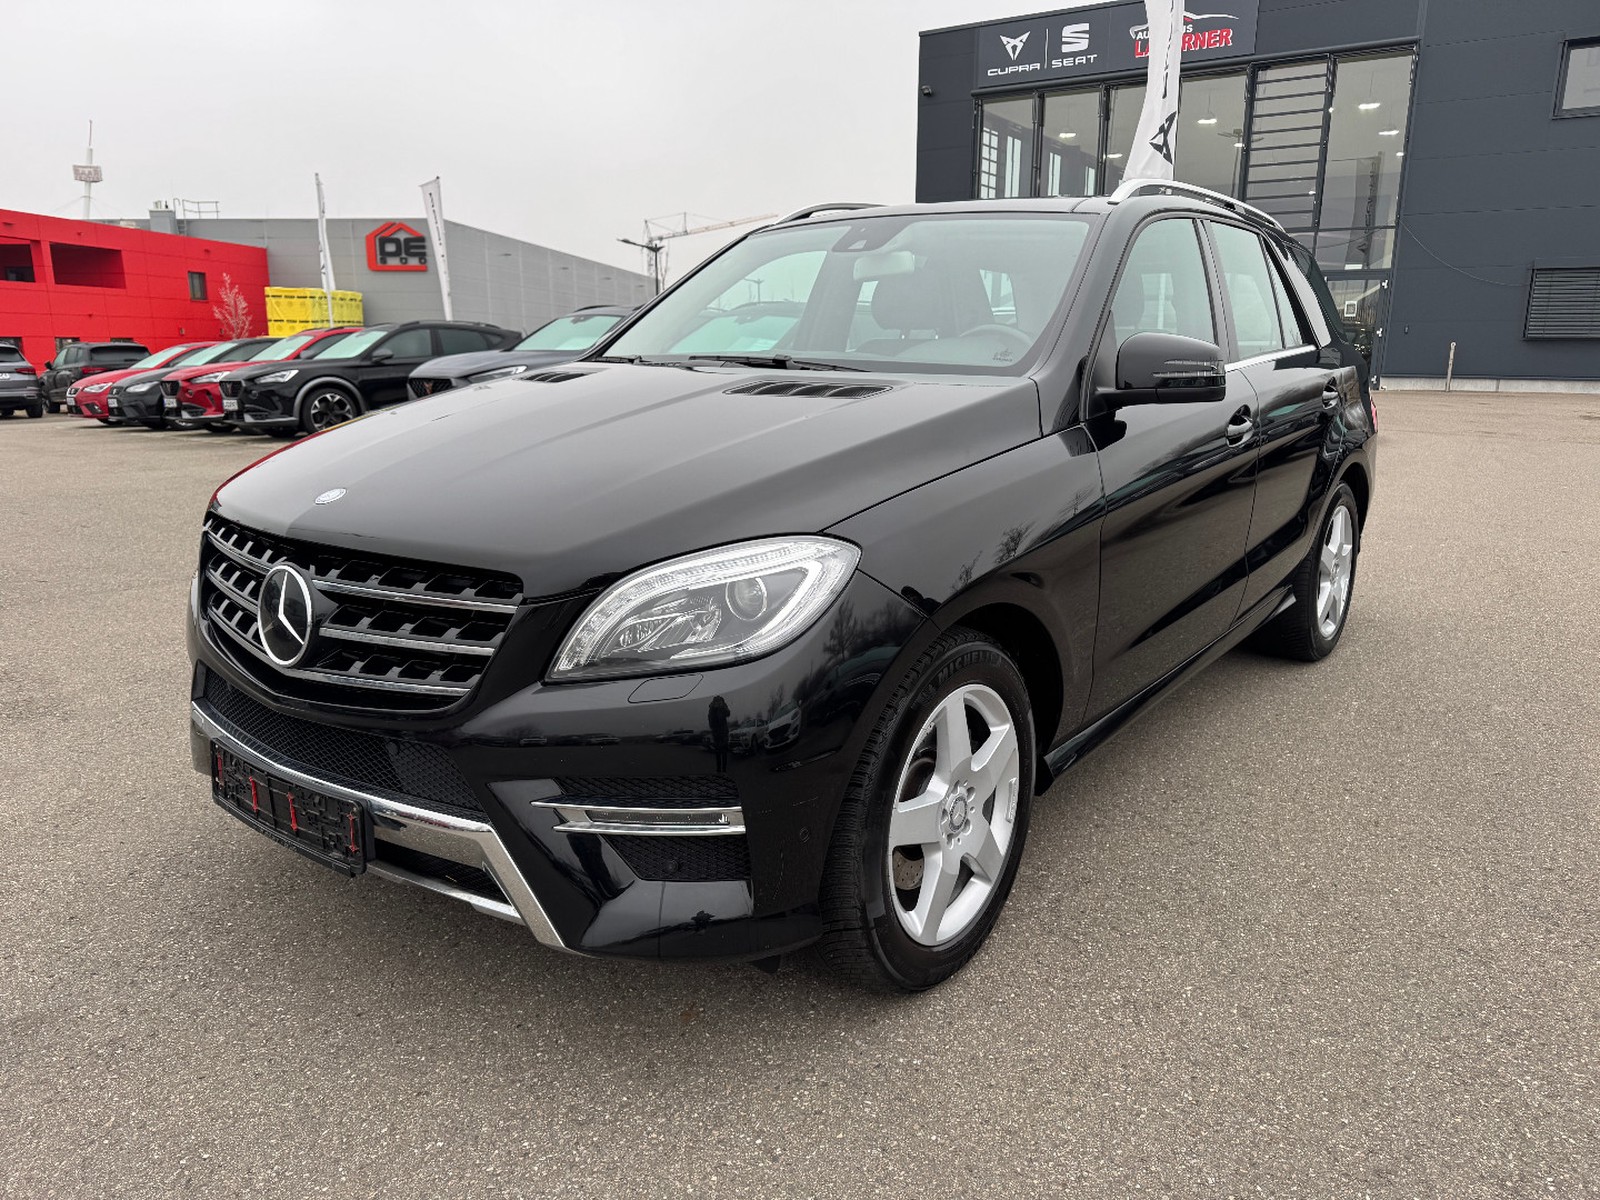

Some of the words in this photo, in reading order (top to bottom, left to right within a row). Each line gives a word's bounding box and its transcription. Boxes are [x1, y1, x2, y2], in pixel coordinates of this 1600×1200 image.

[1051, 54, 1098, 69] SEAT
[987, 62, 1041, 77] CUPRA
[937, 649, 1002, 684] MICHELIN
